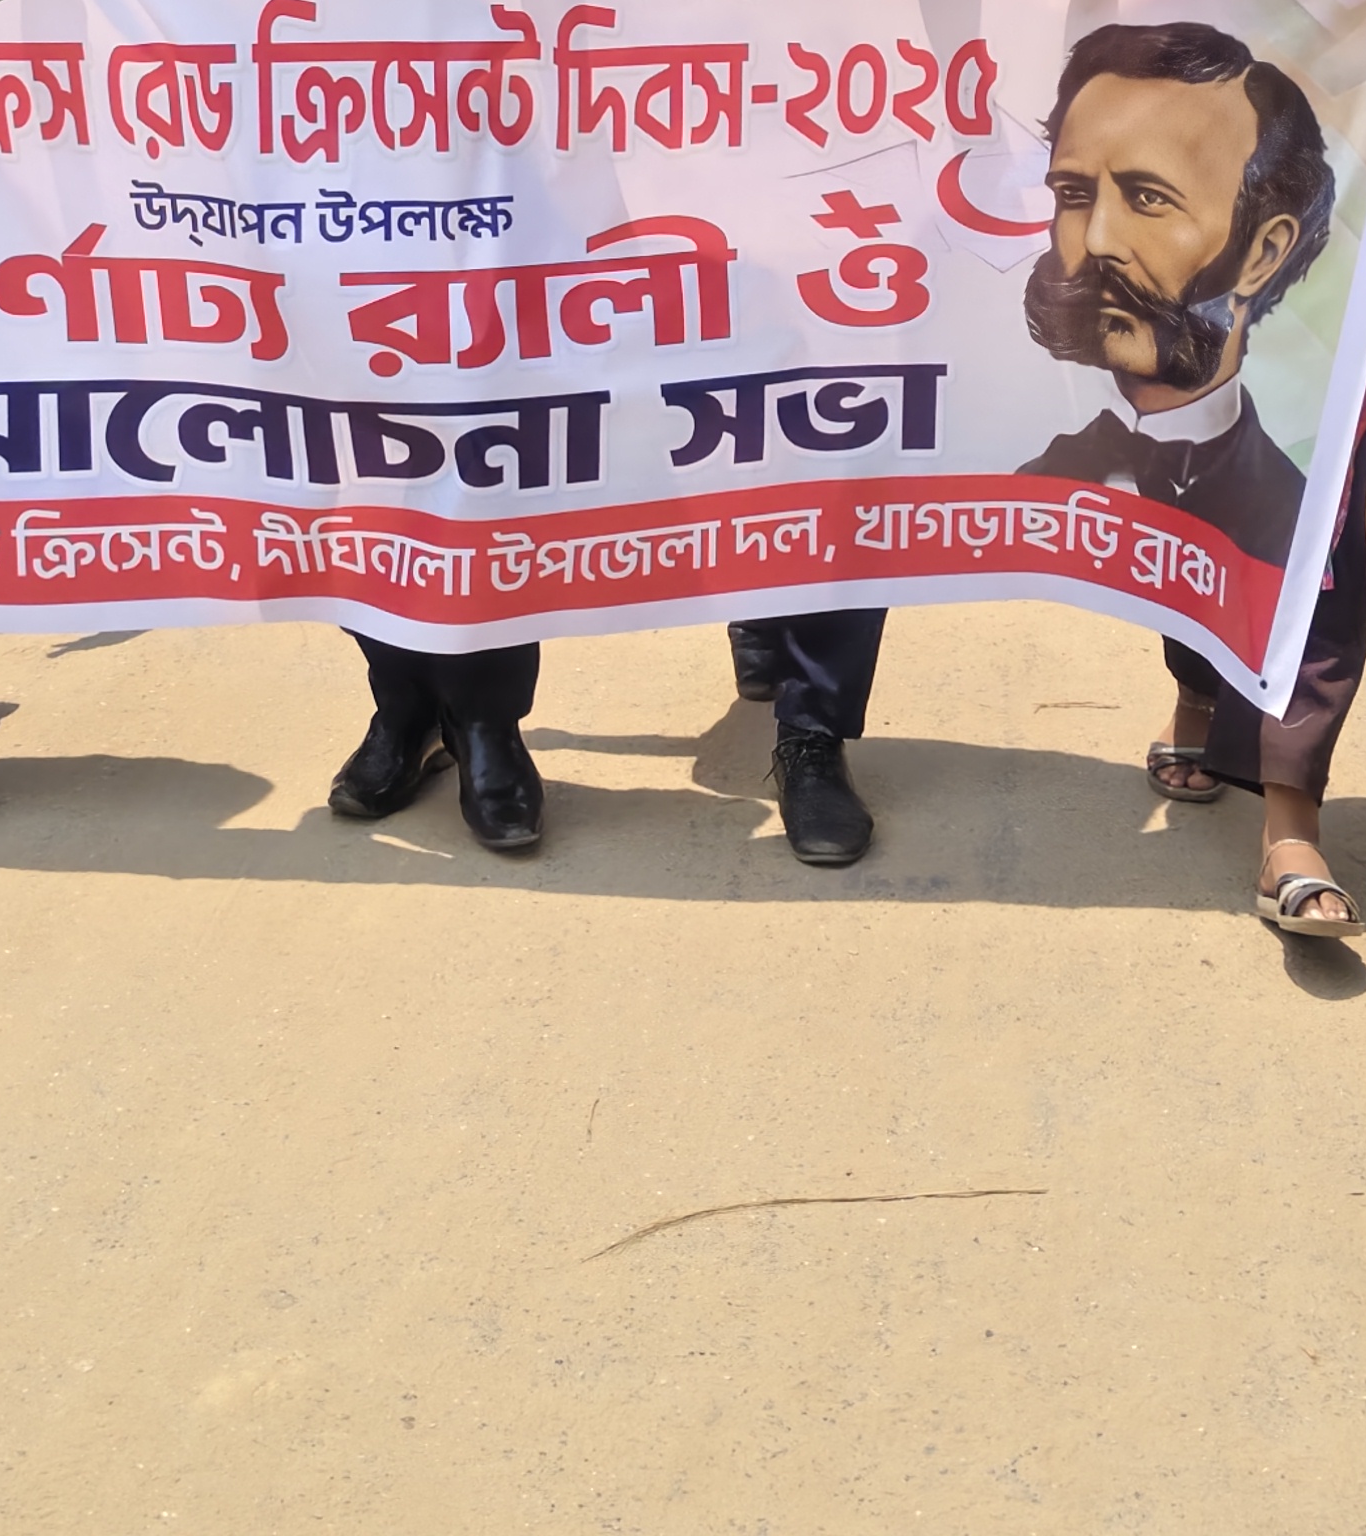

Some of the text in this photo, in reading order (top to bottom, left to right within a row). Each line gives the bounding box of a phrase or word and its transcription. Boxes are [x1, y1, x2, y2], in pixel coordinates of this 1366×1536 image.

[107, 41, 237, 161] রেড
[314, 189, 515, 245] উপলক্ষে
[797, 240, 932, 328] ও
[662, 362, 948, 468] সভা
[11, 508, 242, 582] ক্রিসেন্ট,
[252, 512, 476, 597] দীঘিনালা
[488, 518, 720, 594] উপজেলা
[734, 507, 836, 562] দল,
